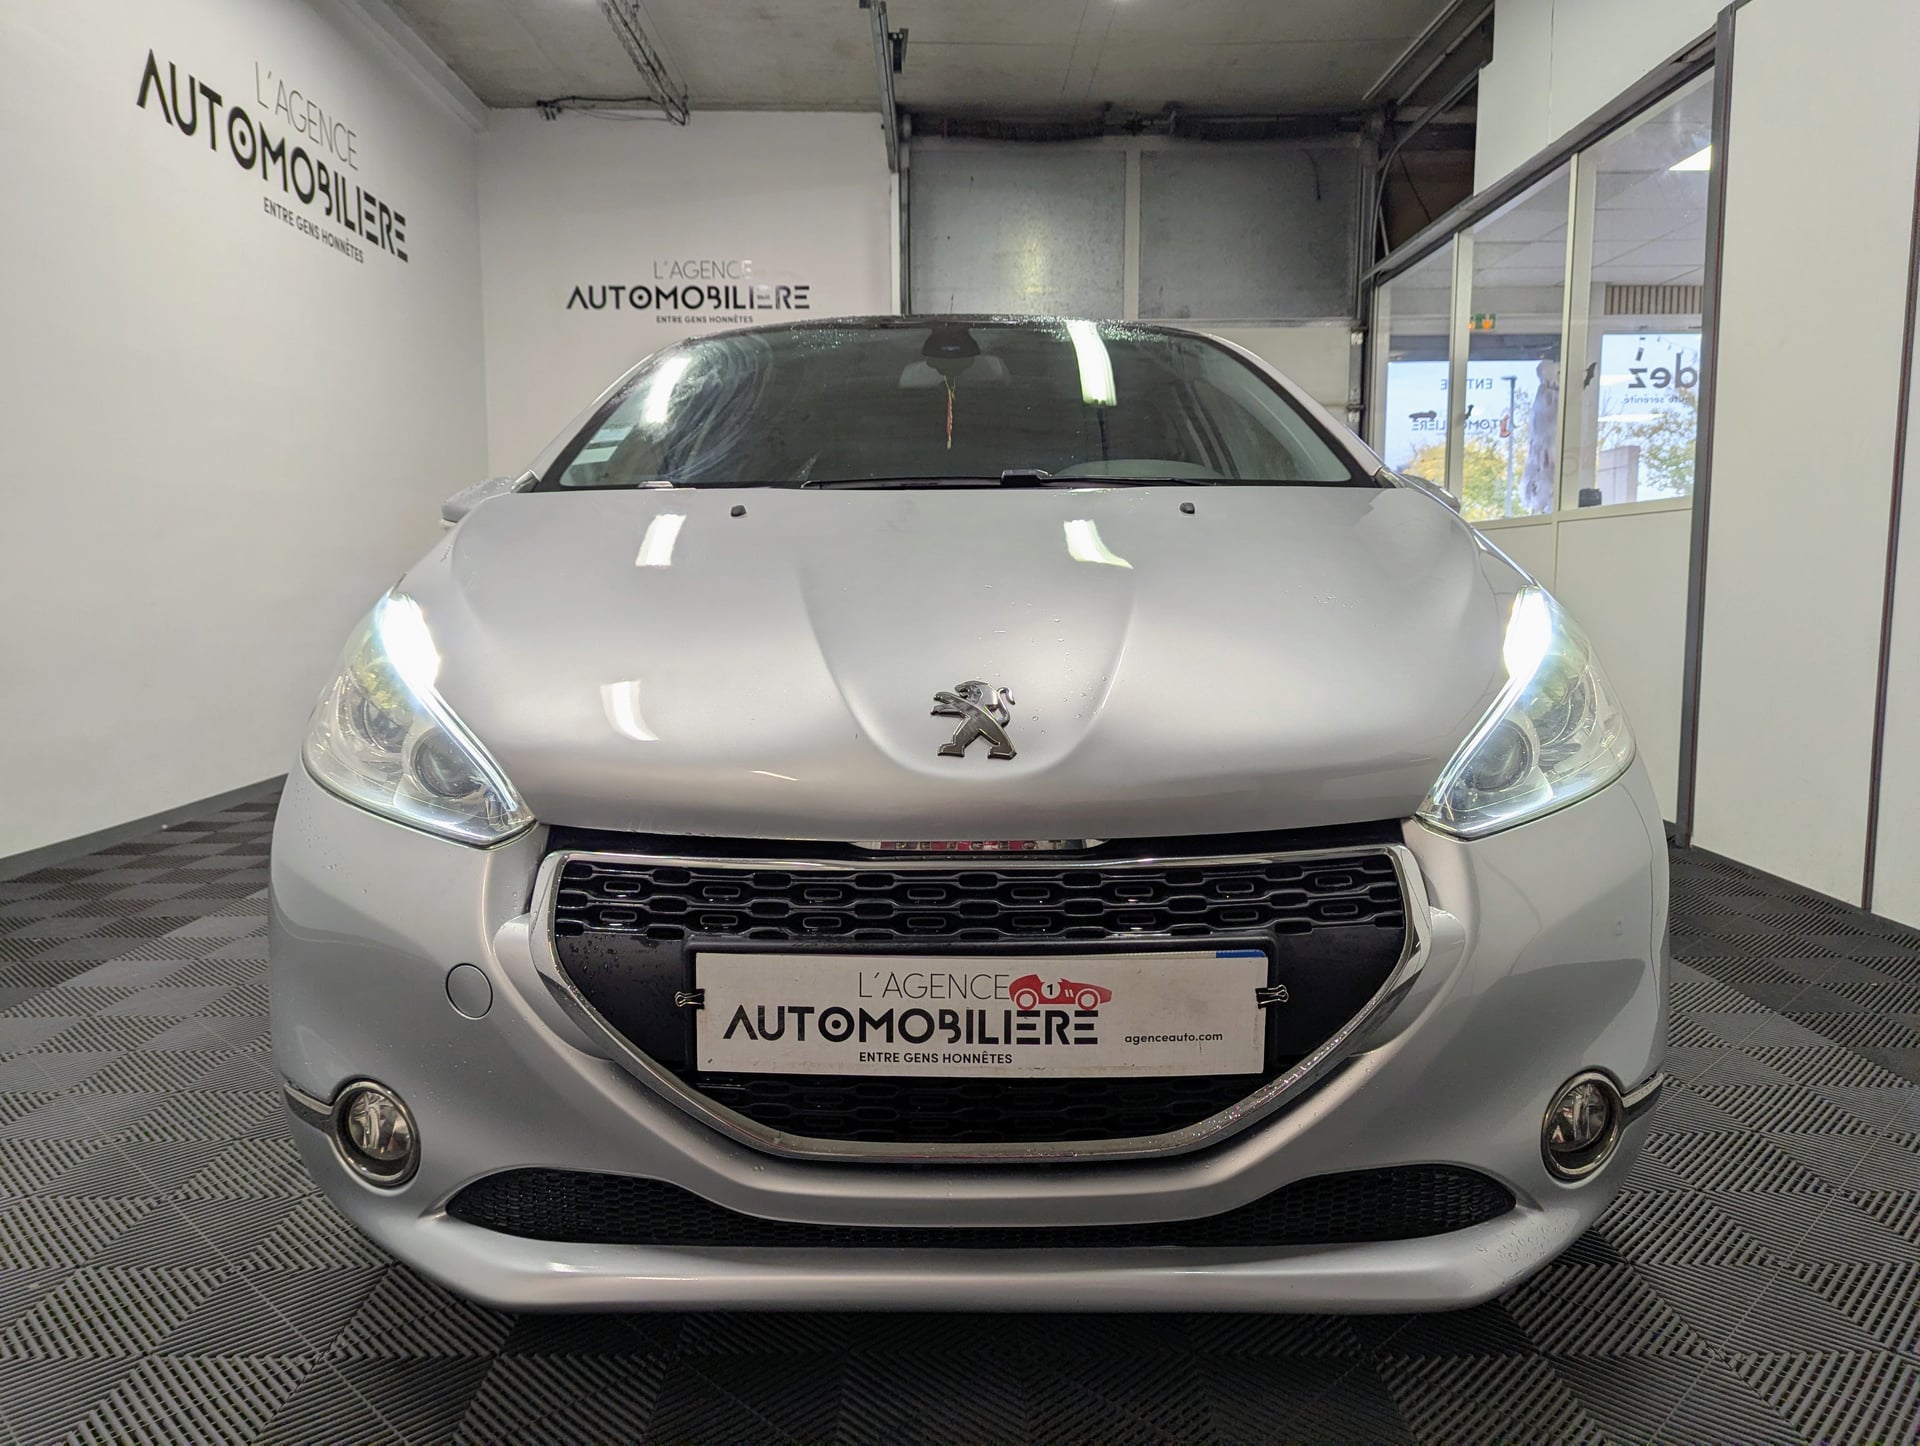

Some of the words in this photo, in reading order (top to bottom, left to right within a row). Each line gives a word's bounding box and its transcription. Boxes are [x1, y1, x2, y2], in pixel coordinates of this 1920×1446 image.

[255, 60, 359, 171] L'AGENCE
[136, 48, 409, 263] AUTOMOBILIERE
[263, 196, 294, 228] ENTRE
[296, 217, 320, 241] GENS
[321, 230, 364, 264] HONNÊTES
[653, 259, 752, 280] L'AGENCE
[566, 285, 810, 310] AUTOMOBILIERE
[656, 315, 682, 324] ENTRE
[684, 315, 707, 324] GENS
[709, 313, 753, 324] HONNÊTES
[859, 973, 1010, 1000] L'AGENCE
[723, 1005, 1099, 1046] AUTOMOBILIERE
[1124, 1032, 1224, 1046] agenceauto.com
[859, 1052, 900, 1064] ENTRE
[903, 1052, 939, 1064] GENS
[942, 1049, 1013, 1065] HONNÊTES
